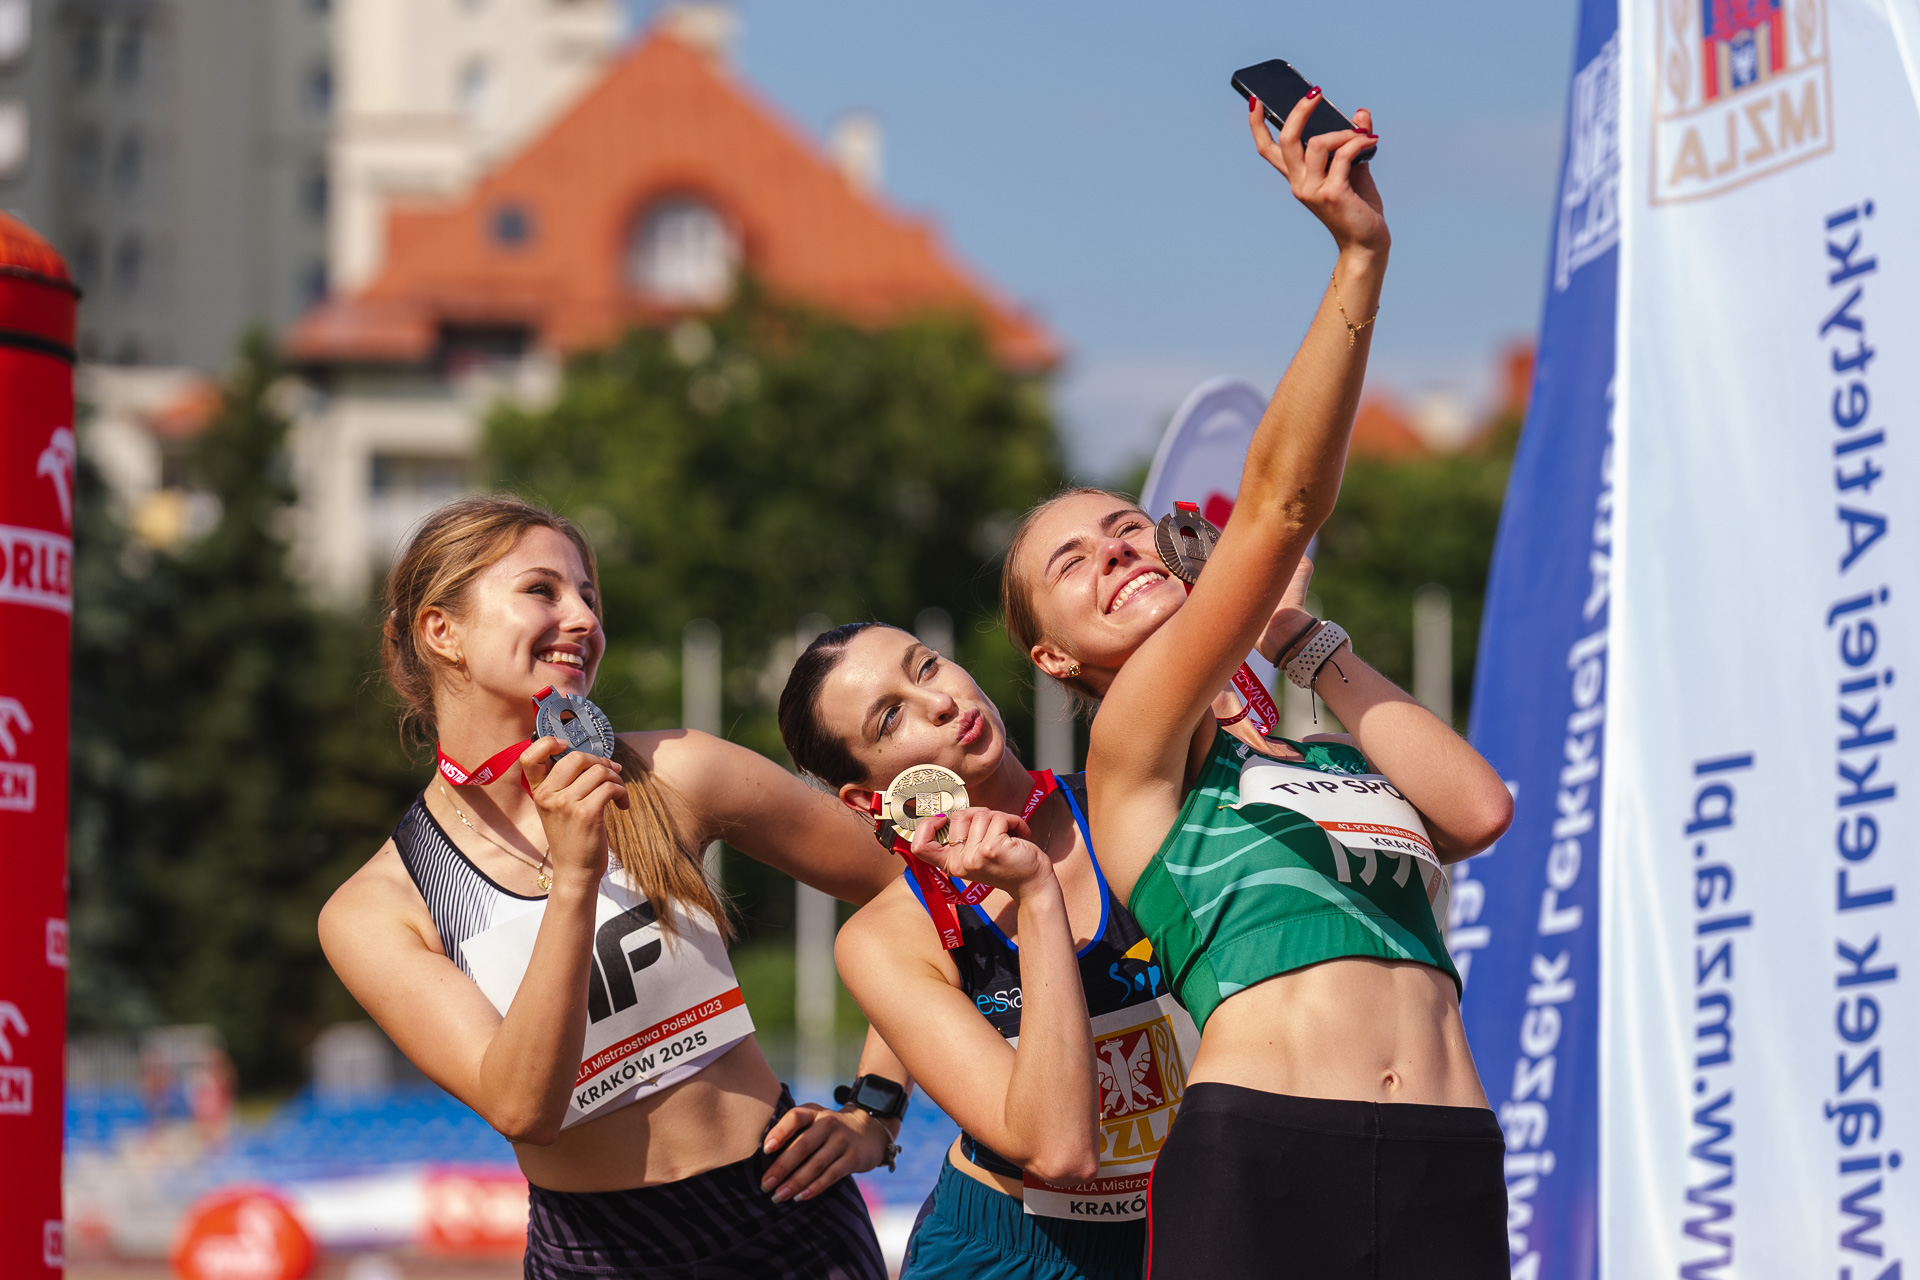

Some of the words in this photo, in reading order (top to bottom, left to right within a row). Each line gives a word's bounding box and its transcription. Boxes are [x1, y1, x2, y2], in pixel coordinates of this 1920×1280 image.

[1269, 780, 1339, 795] TVP
[576, 1053, 656, 1109] KRAKÓW
[659, 1030, 708, 1063] 2025
[592, 1029, 660, 1071] Mistrzostwa
[661, 1010, 698, 1035] Polski
[698, 999, 723, 1018] U23
